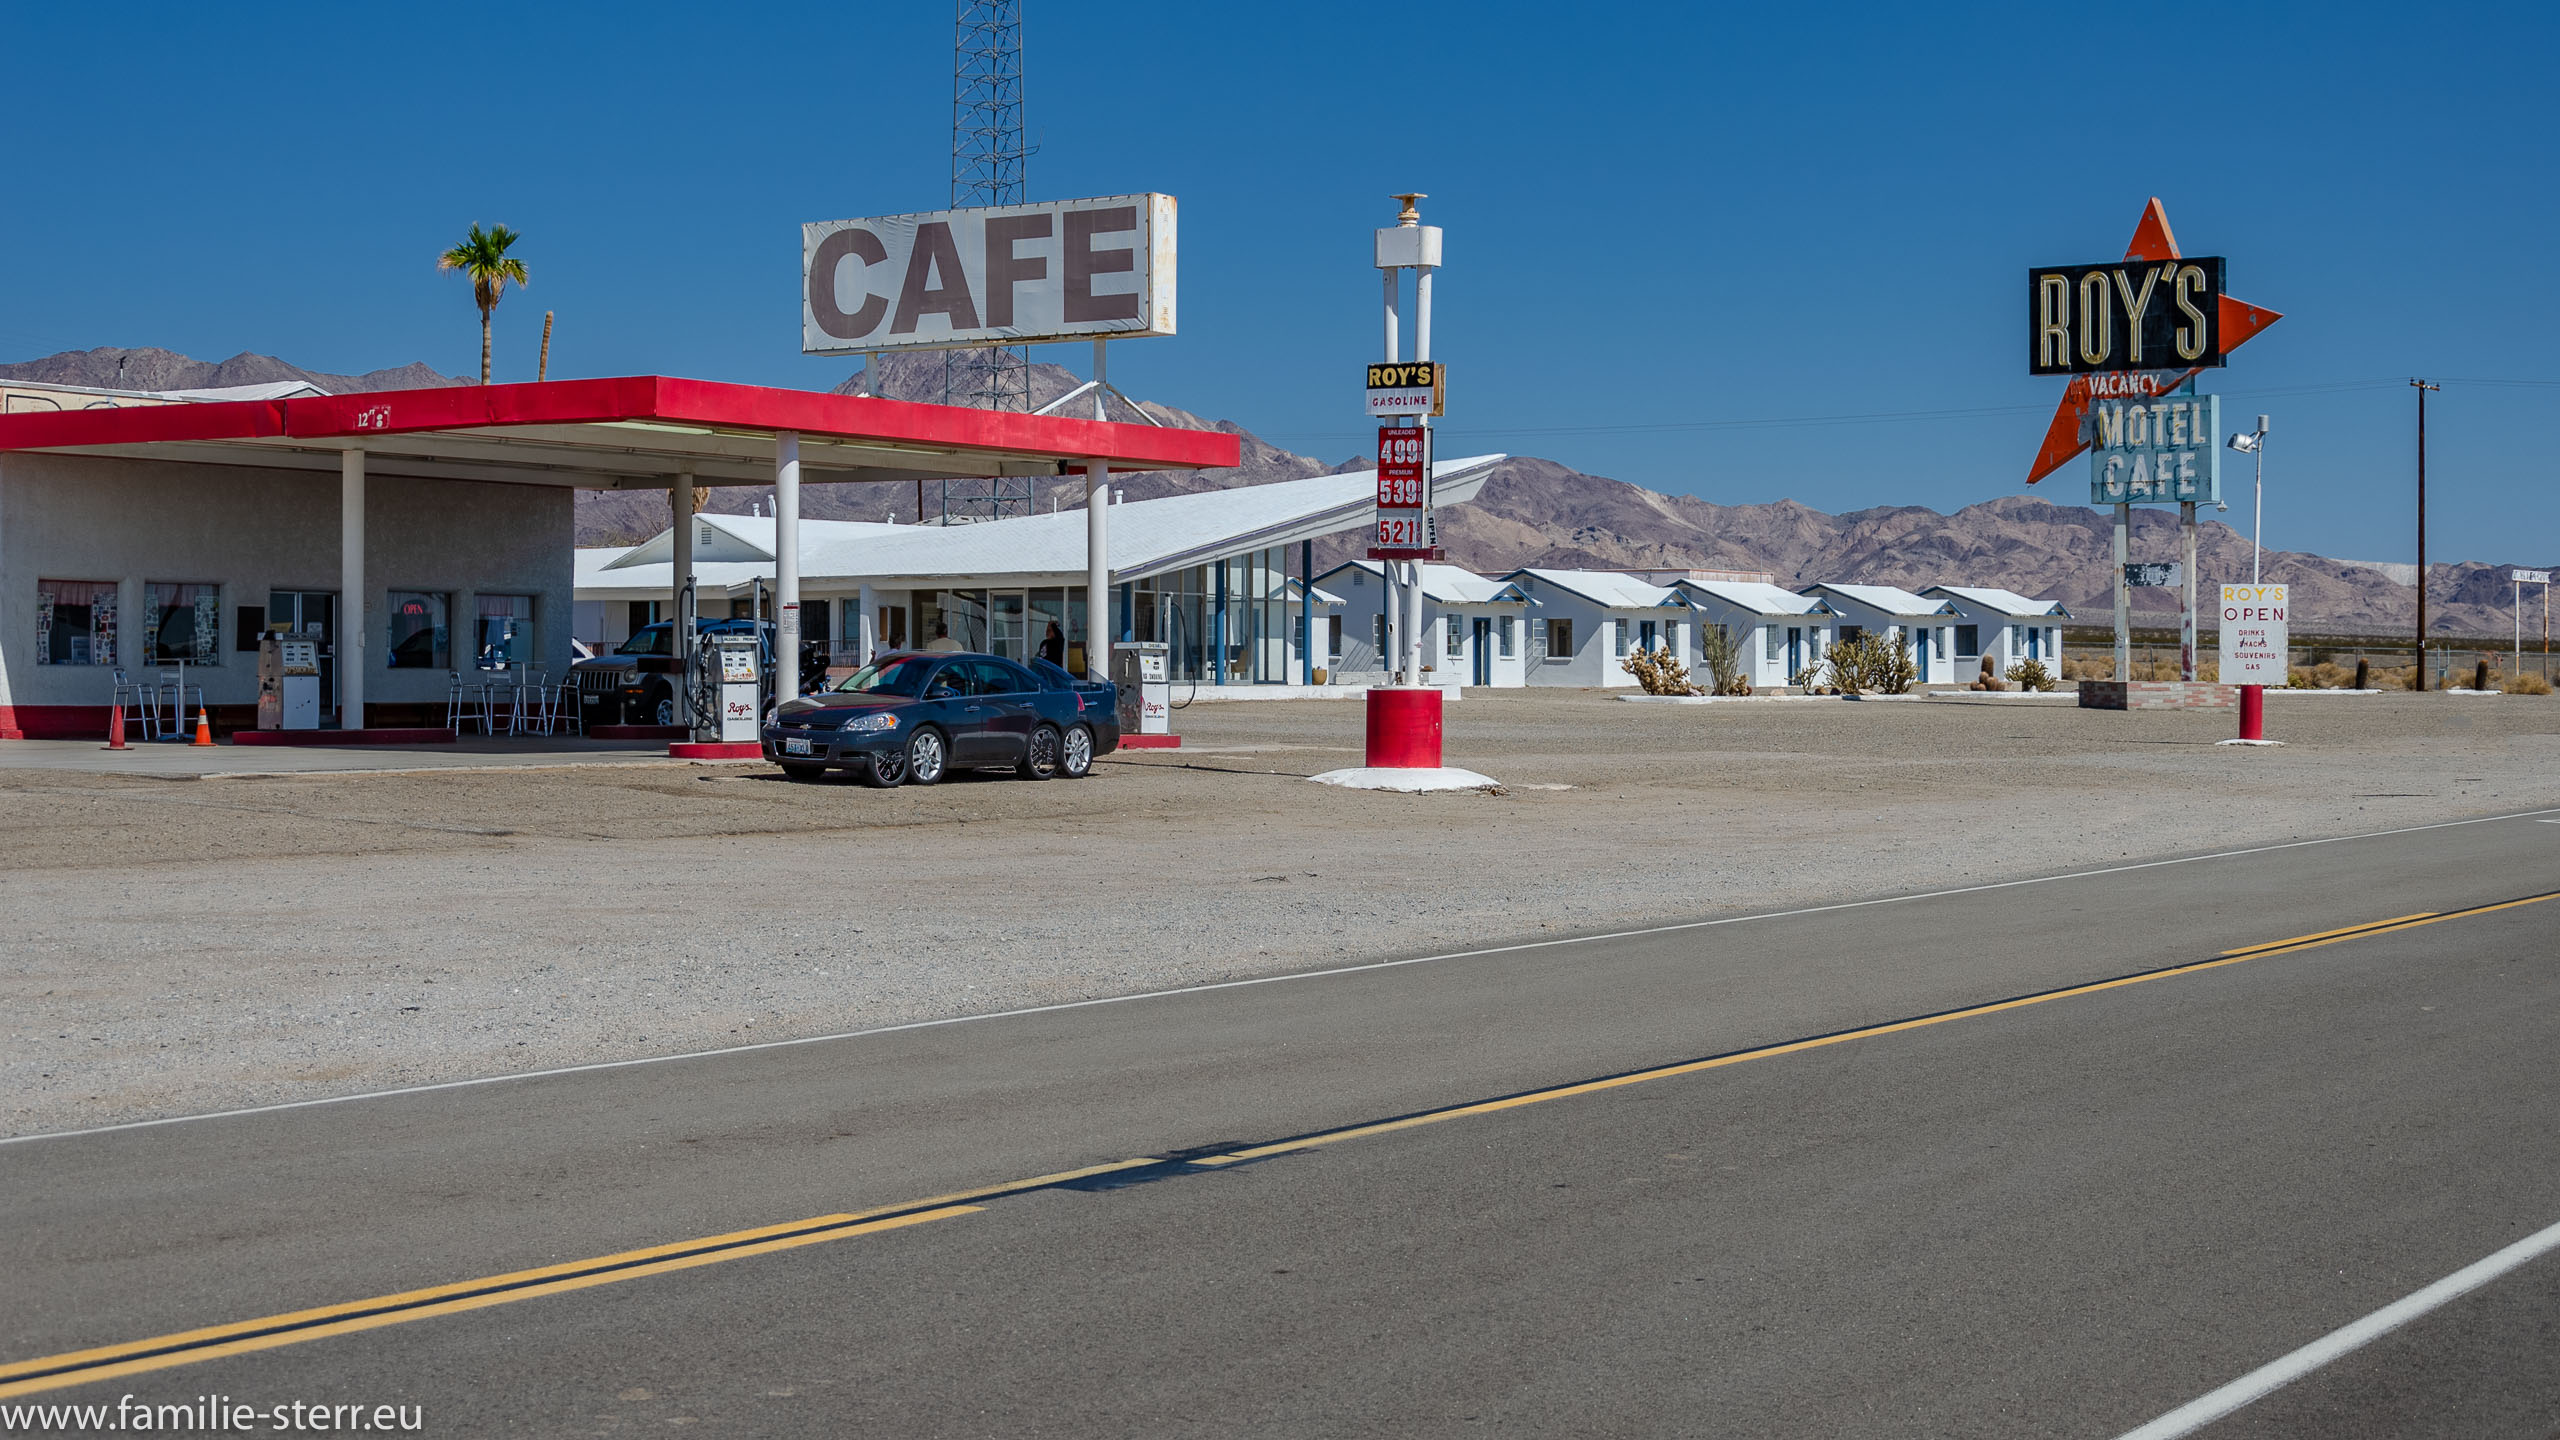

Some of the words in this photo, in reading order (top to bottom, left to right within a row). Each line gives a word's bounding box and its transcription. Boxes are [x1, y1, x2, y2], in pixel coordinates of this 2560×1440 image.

[809, 205, 1139, 340] CAFE
[2040, 261, 2206, 367] ROY'S
[1368, 366, 1431, 386] ROY'S
[2088, 374, 2160, 395] VACANCY
[1372, 396, 1427, 407] GASOLINE
[2098, 402, 2207, 447] MOTEL
[2106, 452, 2197, 497] CAFE
[1428, 517, 1436, 544] OPEN
[2223, 587, 2284, 601] ROY'S
[403, 603, 423, 615] OPEN
[2224, 607, 2284, 621] OPEN
[728, 701, 752, 716] Roy's
